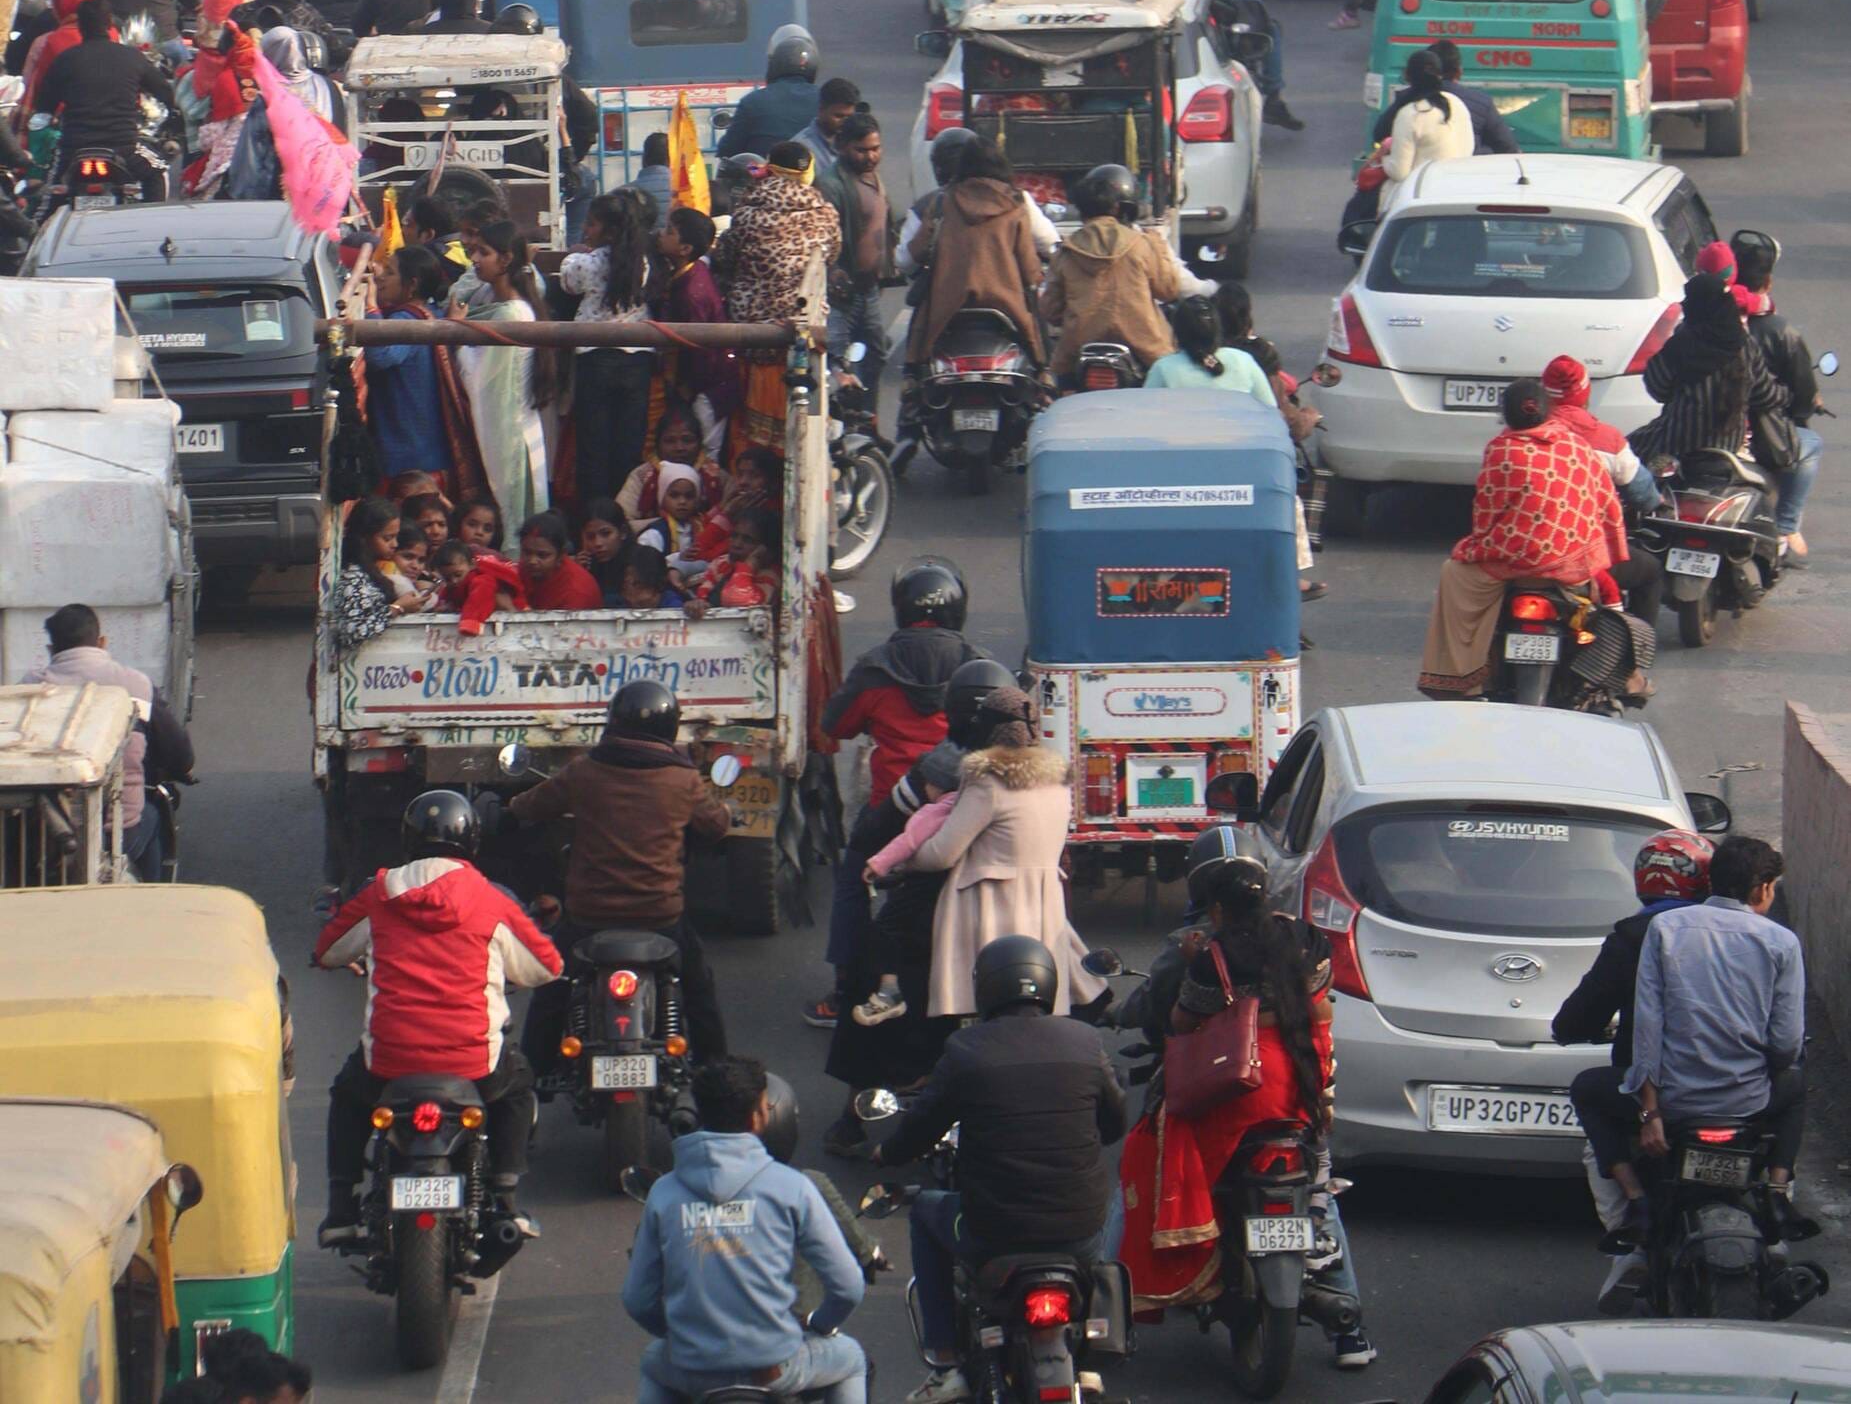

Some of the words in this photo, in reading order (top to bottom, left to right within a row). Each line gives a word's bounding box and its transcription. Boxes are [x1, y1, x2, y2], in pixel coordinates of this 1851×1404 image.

[1476, 50, 1532, 67] CNG
[1449, 1096, 1581, 1126] UP32GP762
[1258, 1219, 1304, 1234] UP32N
[1258, 1234, 1304, 1249] D6273
